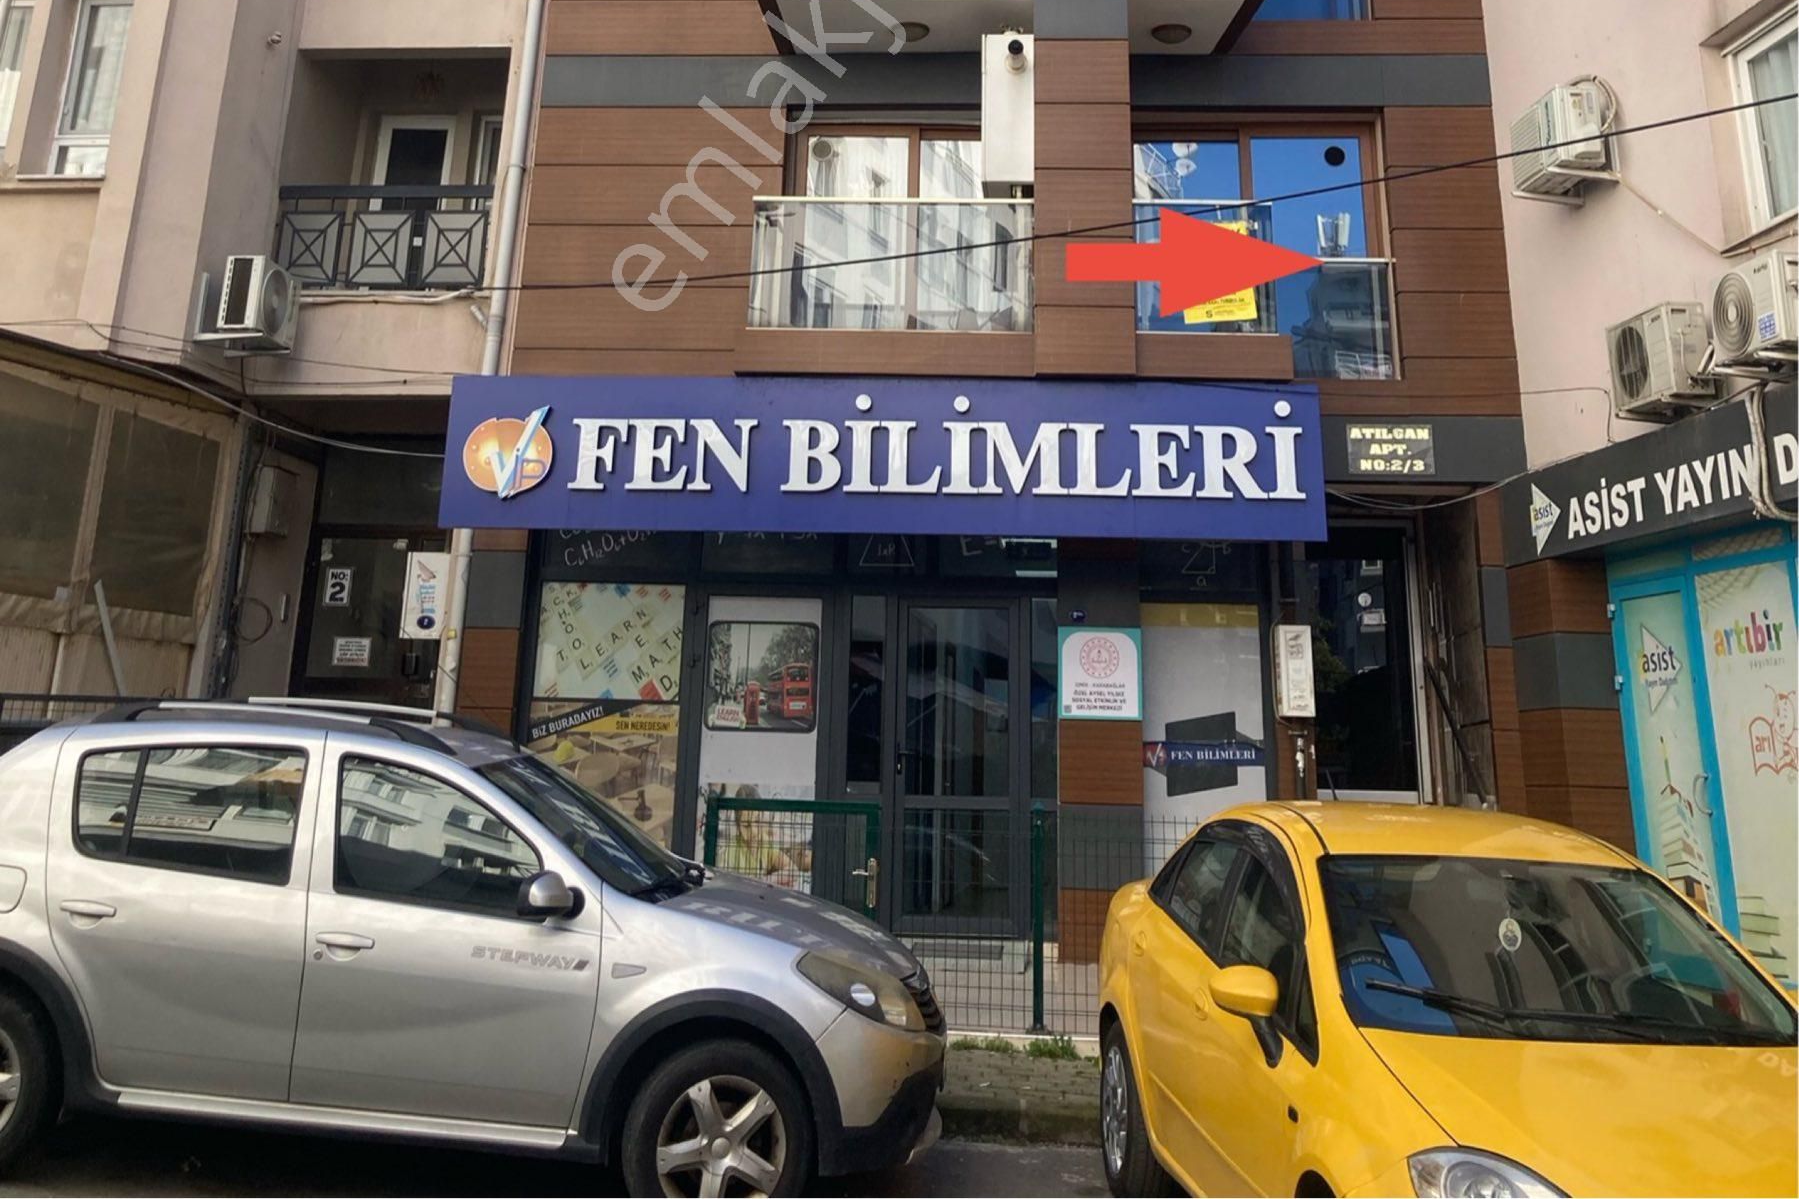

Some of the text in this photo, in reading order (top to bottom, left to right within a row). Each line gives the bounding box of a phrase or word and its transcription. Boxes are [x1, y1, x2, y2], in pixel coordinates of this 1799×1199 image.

[567, 393, 1306, 500] FEN BİLİMLERİ
[1369, 443, 1412, 455] APT.
[1360, 459, 1425, 473] NO:2/3
[1568, 476, 1646, 540] ASİST
[1653, 444, 1757, 515] YAYIN
[331, 571, 348, 581] NO:
[329, 582, 346, 602] 2
[1714, 610, 1783, 657] artıbir
[1642, 645, 1676, 673] asist
[549, 705, 604, 733] BURADAYIZ!
[1171, 749, 1194, 760] FEN
[471, 945, 575, 970] STEPWAY
